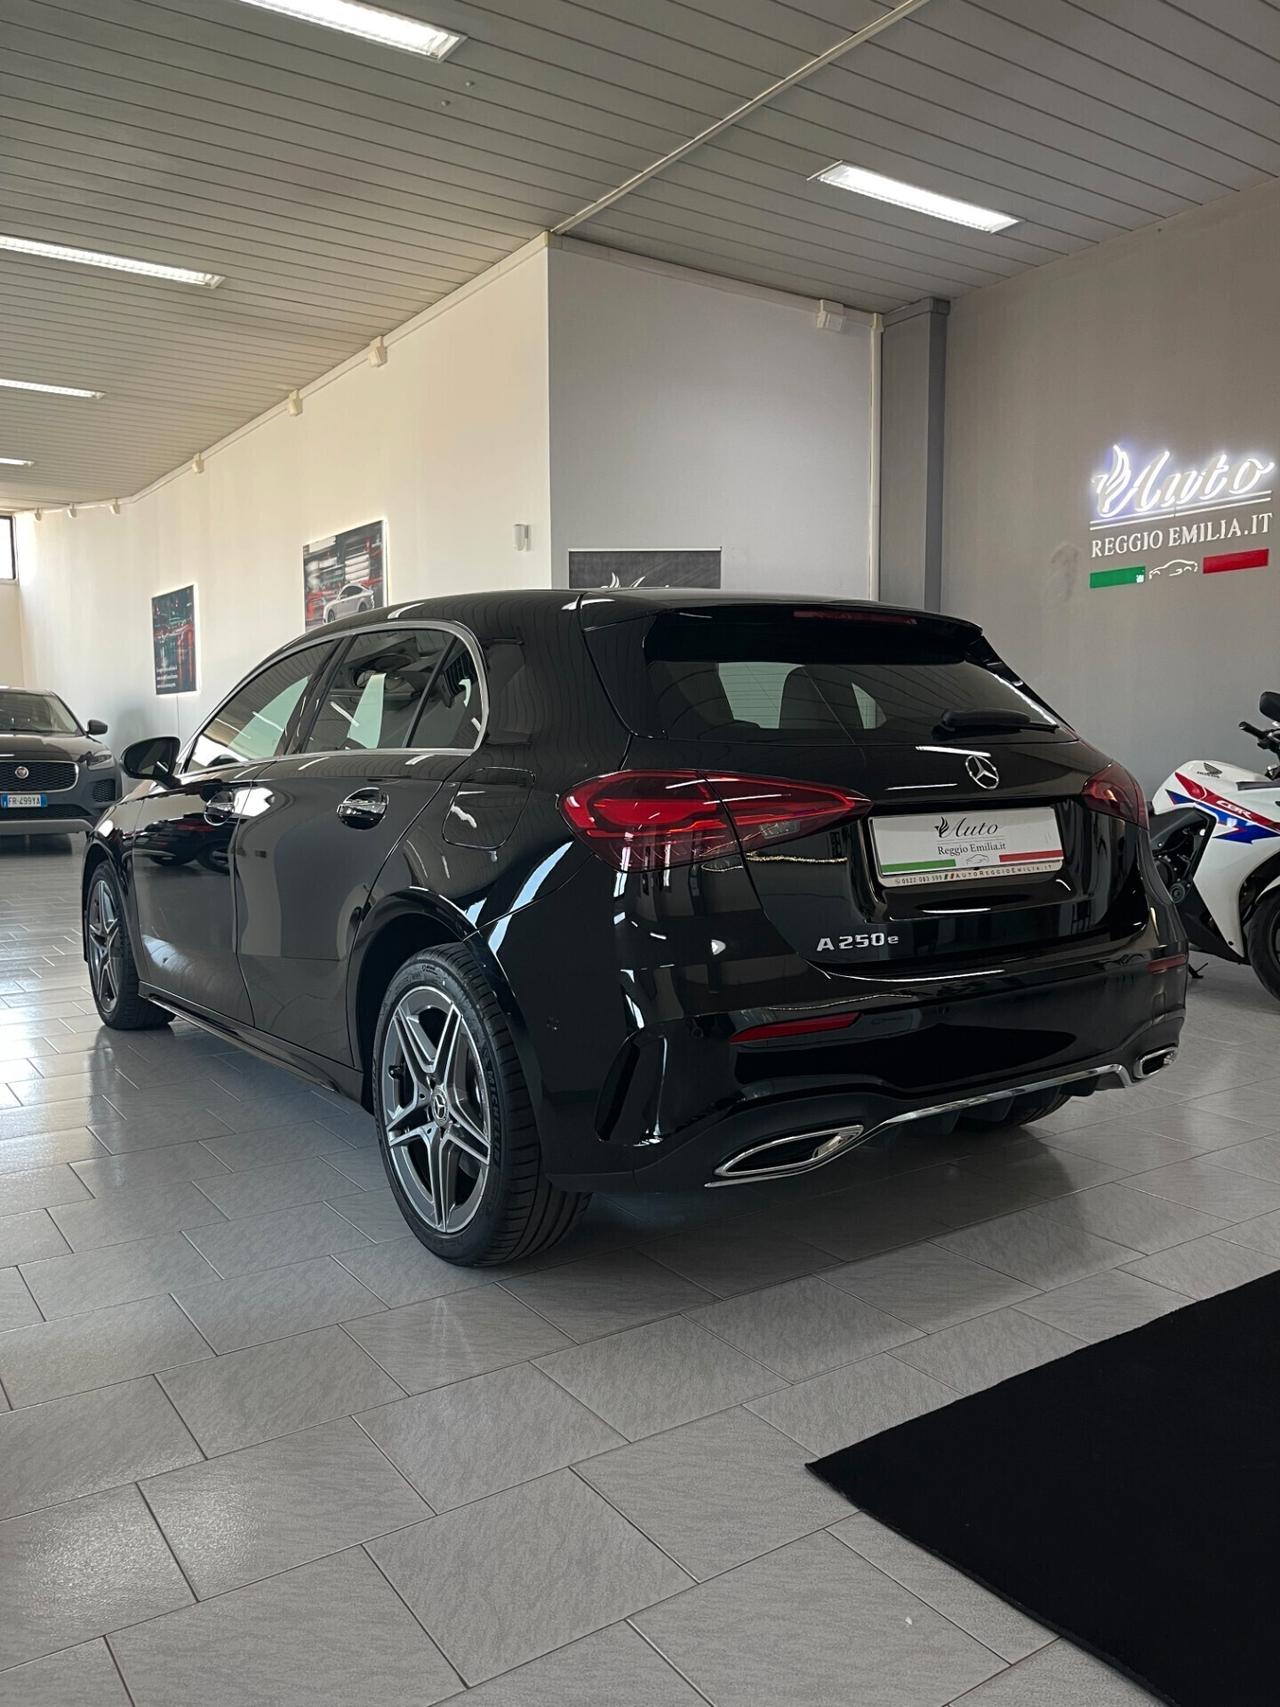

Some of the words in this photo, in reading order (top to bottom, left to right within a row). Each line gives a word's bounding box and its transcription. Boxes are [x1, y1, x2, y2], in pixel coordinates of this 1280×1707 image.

[1099, 448, 1276, 518] Auto
[1091, 530, 1164, 558] REGGIO
[1168, 513, 1273, 547] EMILIA.IT
[938, 816, 999, 839] Auto
[937, 845, 969, 857] Reggio
[970, 842, 1007, 854] Emilia.it
[816, 937, 835, 951] A
